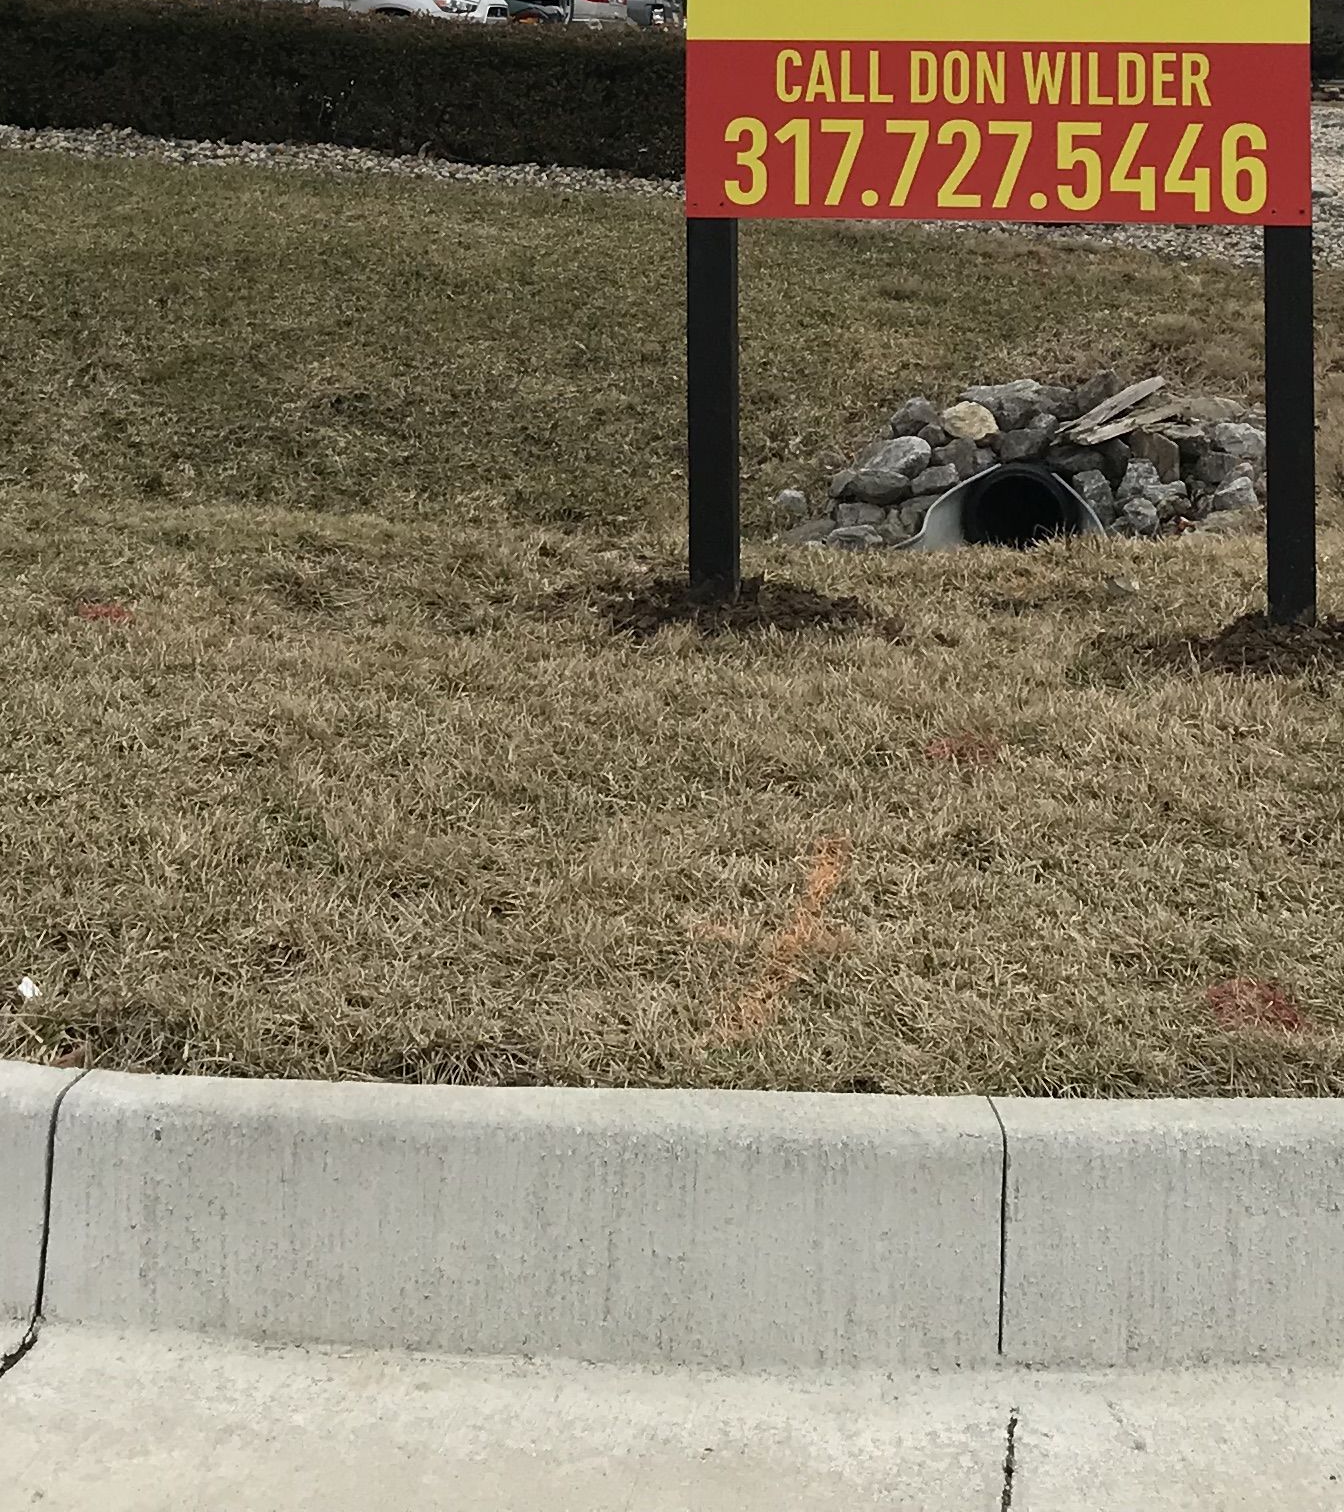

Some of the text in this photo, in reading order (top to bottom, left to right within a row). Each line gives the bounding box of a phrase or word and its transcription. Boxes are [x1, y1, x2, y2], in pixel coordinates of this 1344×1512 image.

[775, 49, 1211, 106] CALL DON WILDER
[723, 117, 1268, 213] 317.727.5446
